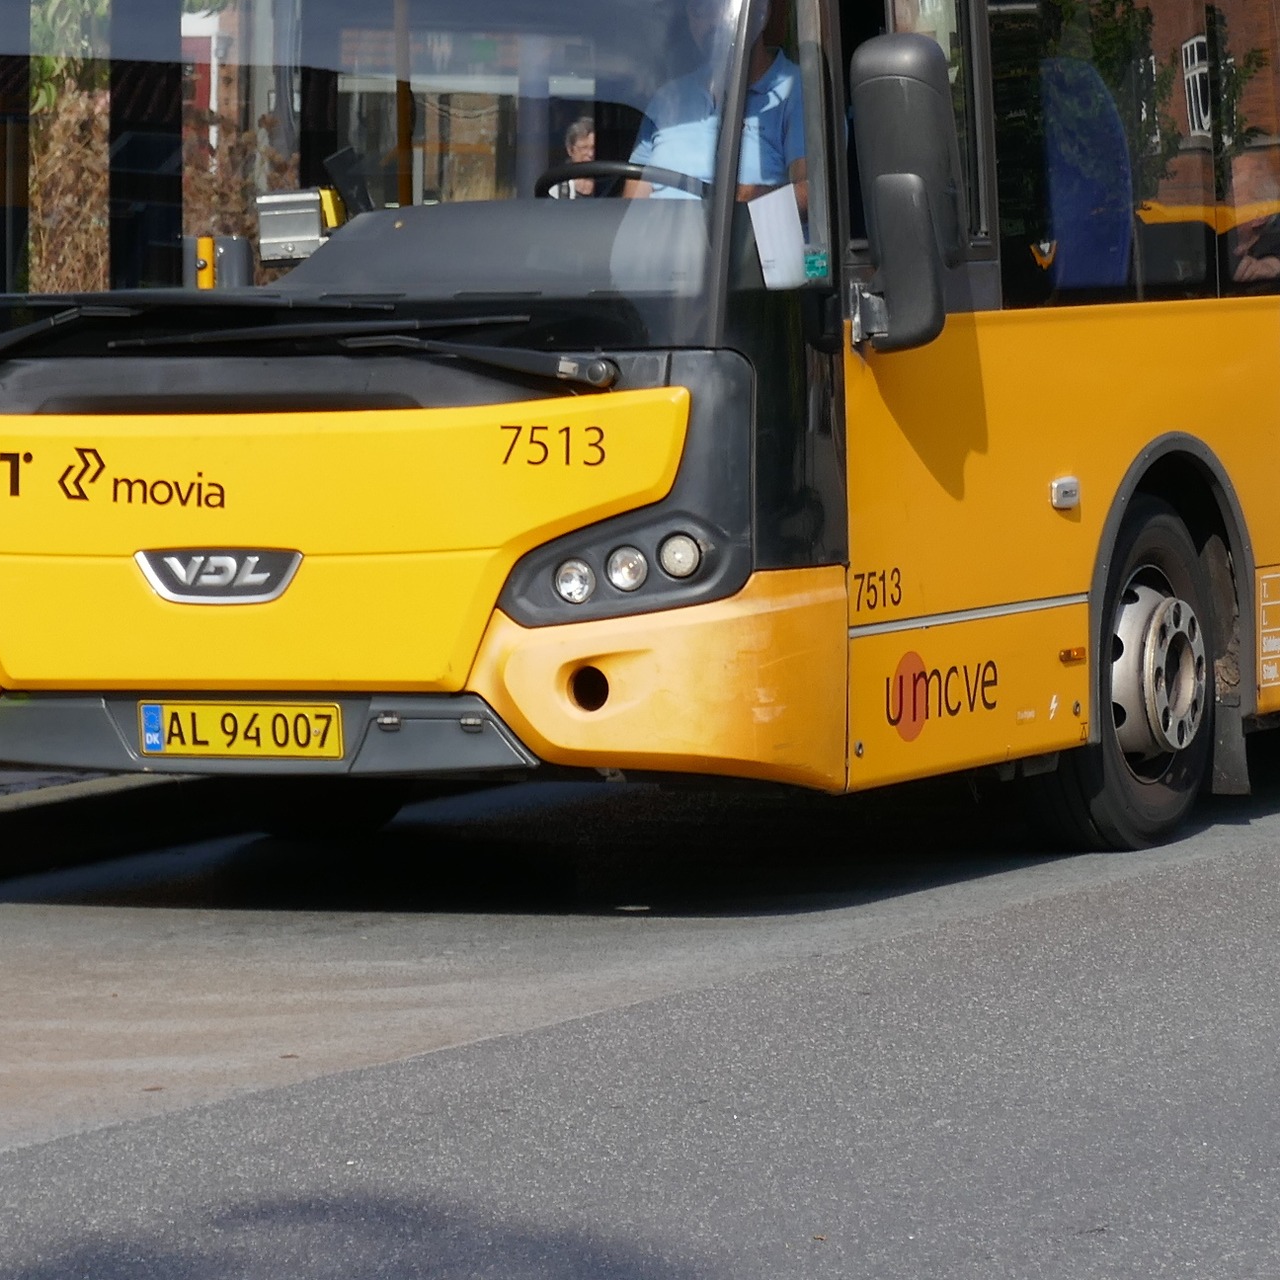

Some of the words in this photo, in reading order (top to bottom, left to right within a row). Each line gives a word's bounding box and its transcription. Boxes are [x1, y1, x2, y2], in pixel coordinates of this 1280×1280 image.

[498, 424, 607, 468] 7513
[111, 470, 226, 510] movia
[162, 556, 271, 586] VDL
[854, 567, 902, 612] 7513
[145, 732, 160, 745] DK
[166, 711, 209, 747] AL
[220, 712, 261, 748] 94
[271, 712, 333, 748] 007
